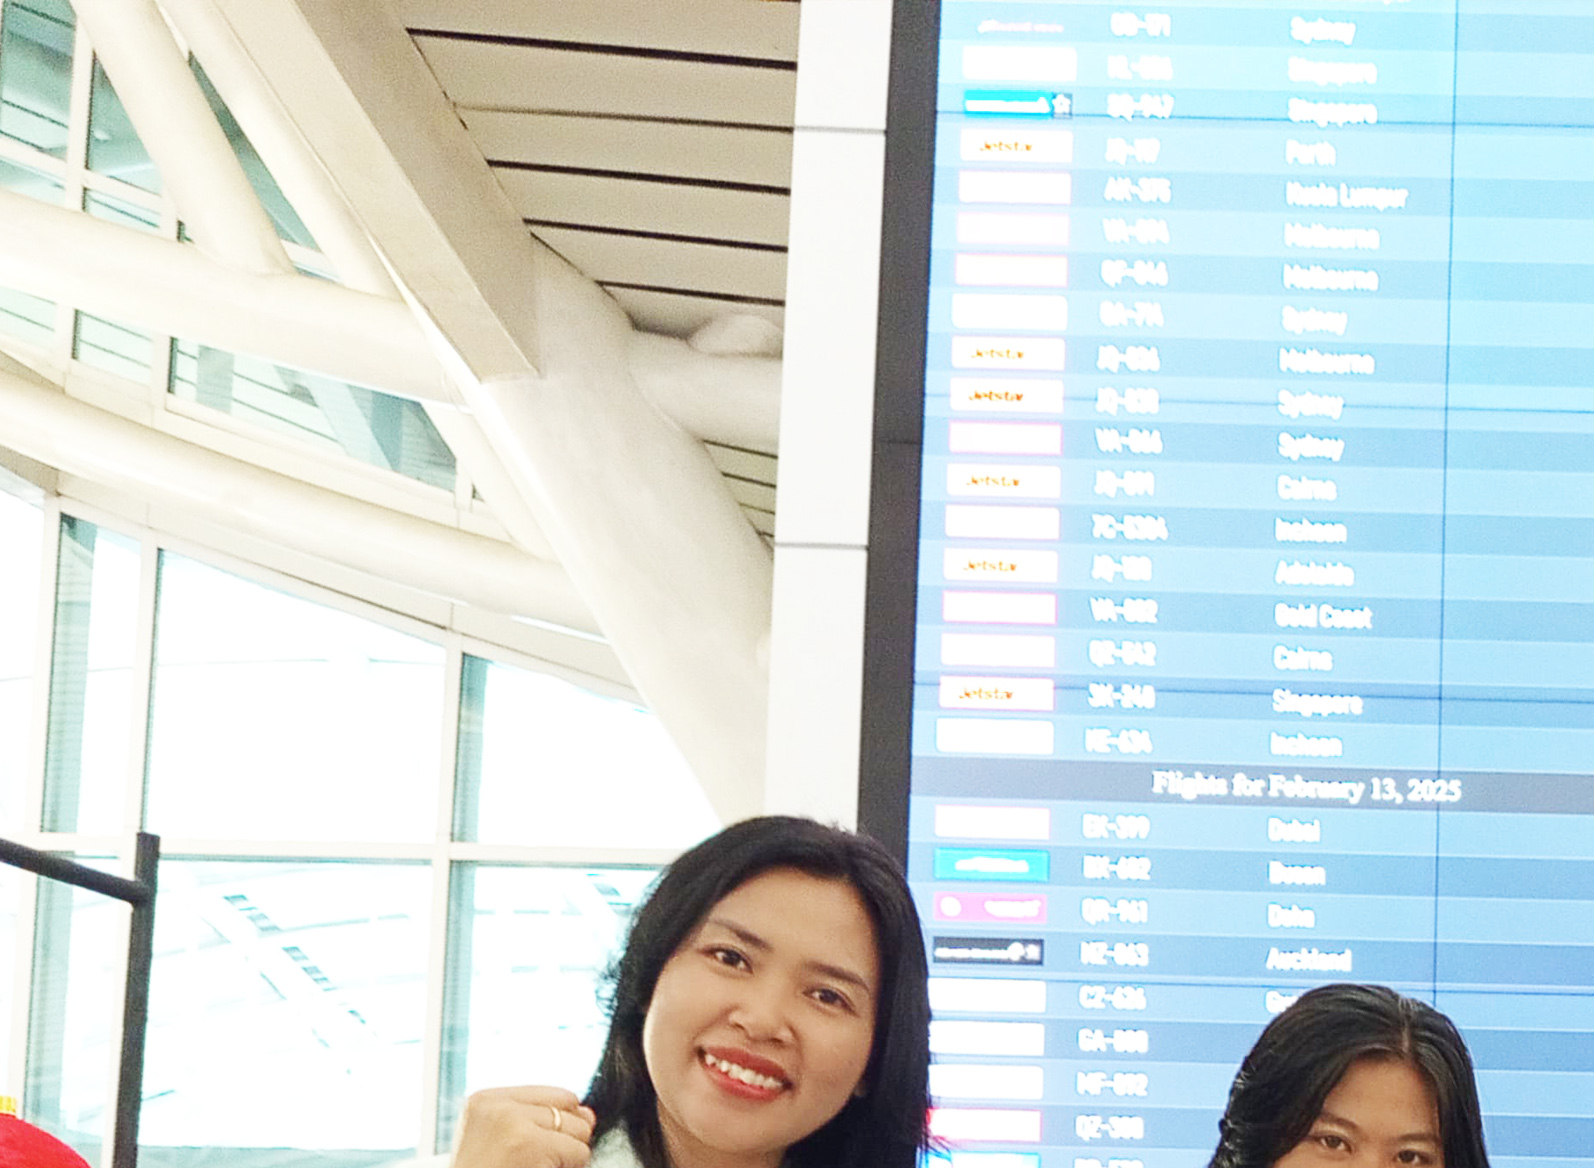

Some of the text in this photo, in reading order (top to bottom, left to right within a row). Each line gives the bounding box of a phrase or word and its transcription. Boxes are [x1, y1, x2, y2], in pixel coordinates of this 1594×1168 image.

[968, 390, 1024, 402] Jetstar
[958, 687, 1014, 700] Jetstar
[1151, 771, 1461, 804] Flights for February 13, 2025
[1266, 948, 1353, 973] Auckland
